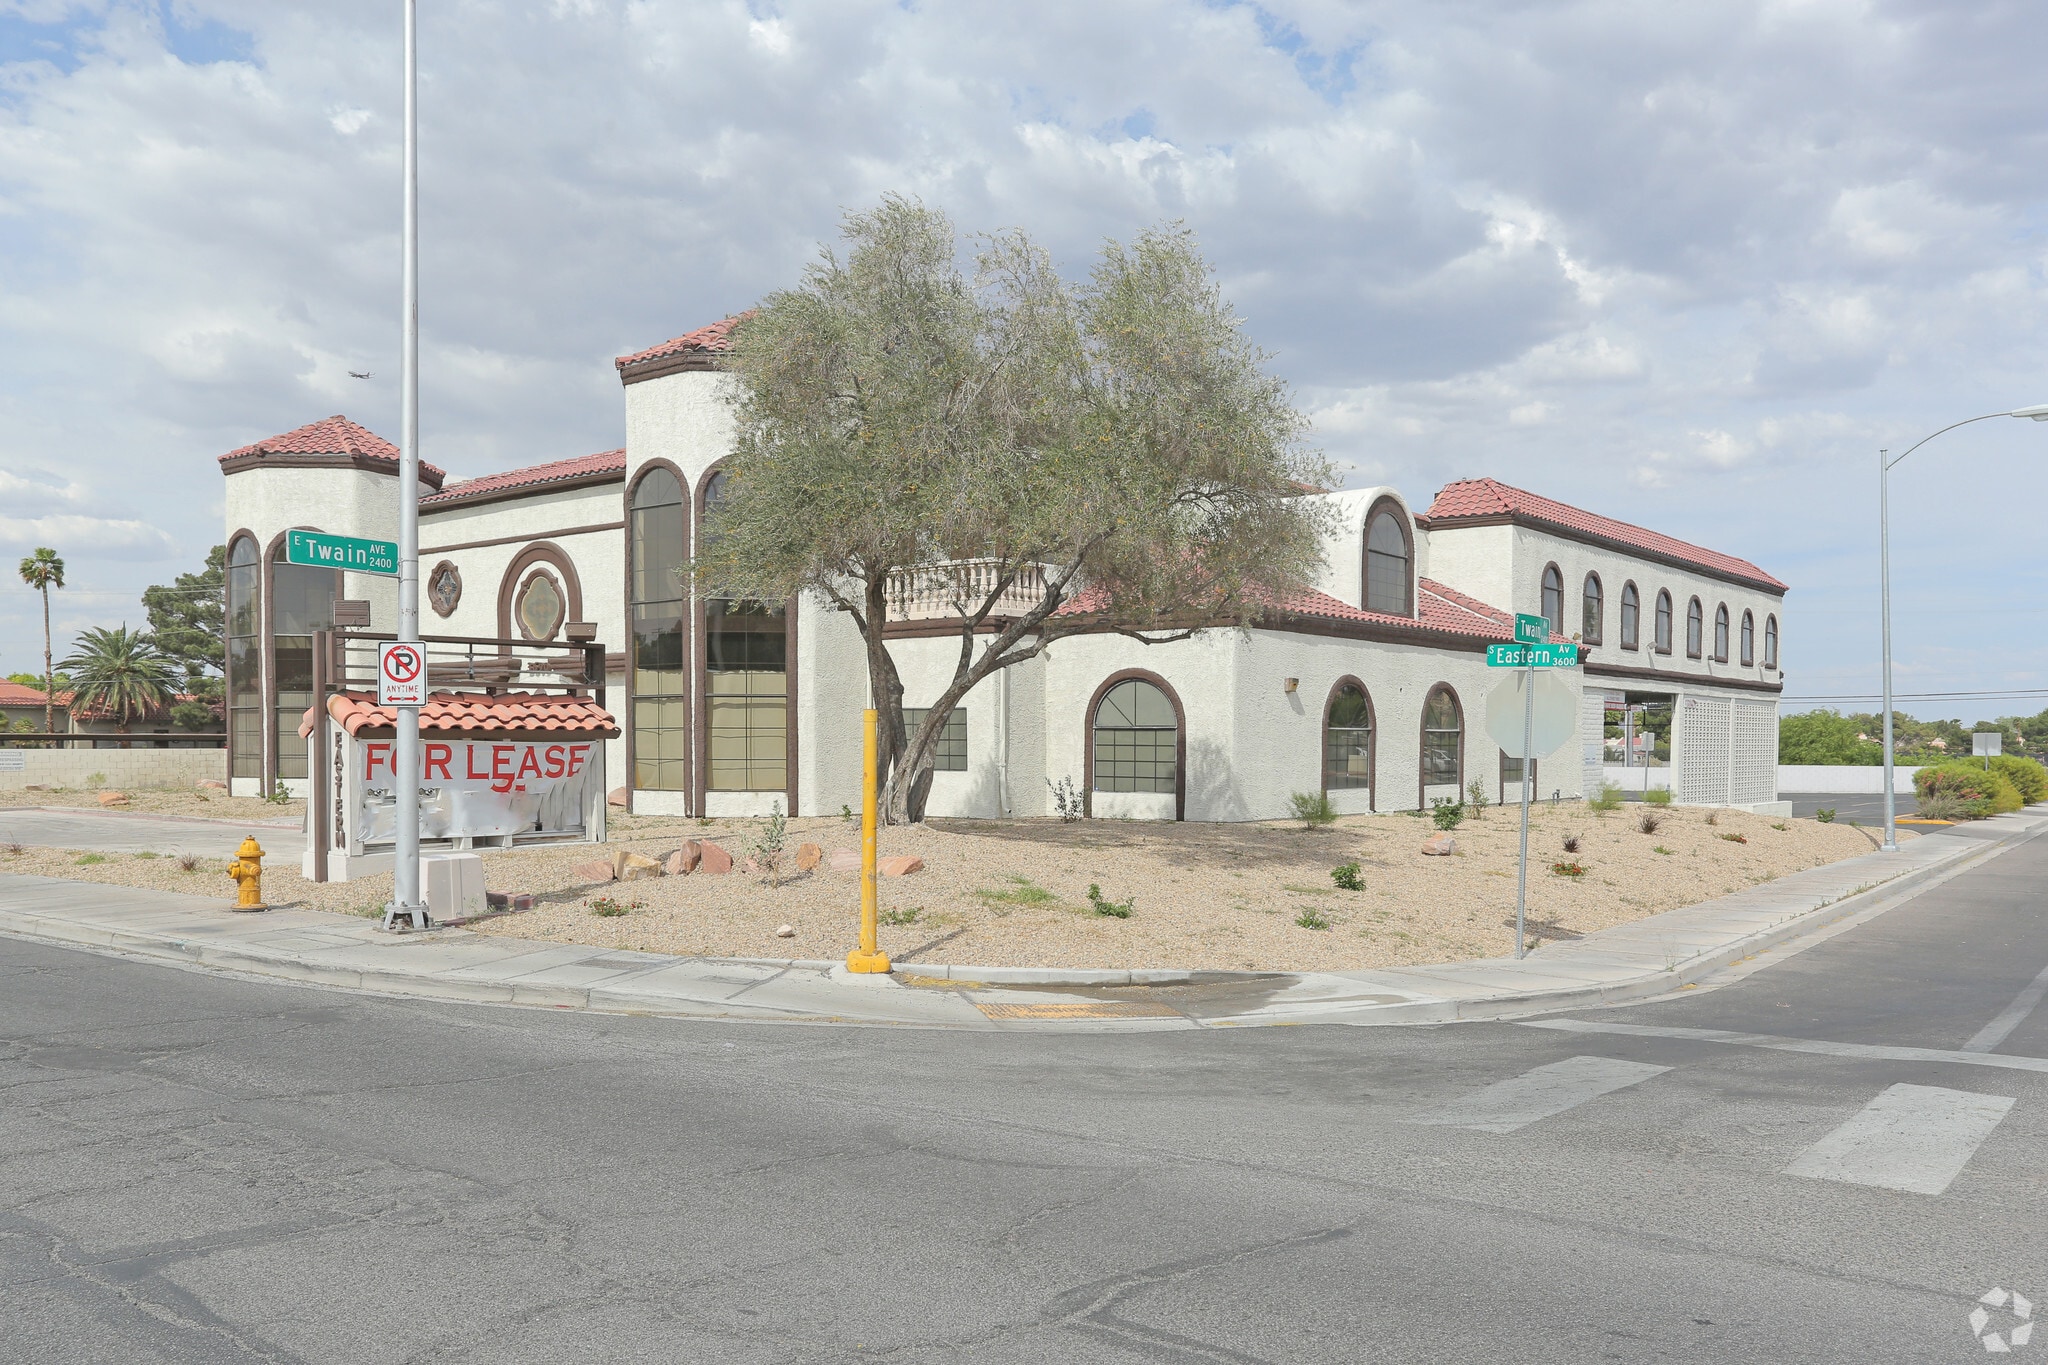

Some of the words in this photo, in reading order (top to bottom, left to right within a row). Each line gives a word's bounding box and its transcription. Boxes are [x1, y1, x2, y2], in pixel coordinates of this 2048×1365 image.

[294, 535, 301, 546] E
[305, 539, 367, 564] Twain
[369, 543, 386, 555] AVE
[369, 557, 393, 569] 2400
[1520, 619, 1541, 639] Twain
[1488, 645, 1495, 655] S
[1496, 647, 1550, 664] Eastern
[1558, 645, 1570, 653] Av
[1552, 657, 1575, 666] 3600
[386, 684, 419, 693] ANYTIME
[366, 743, 453, 781] FR
[465, 744, 591, 781] LEASE
[334, 731, 346, 850] EASTERN
